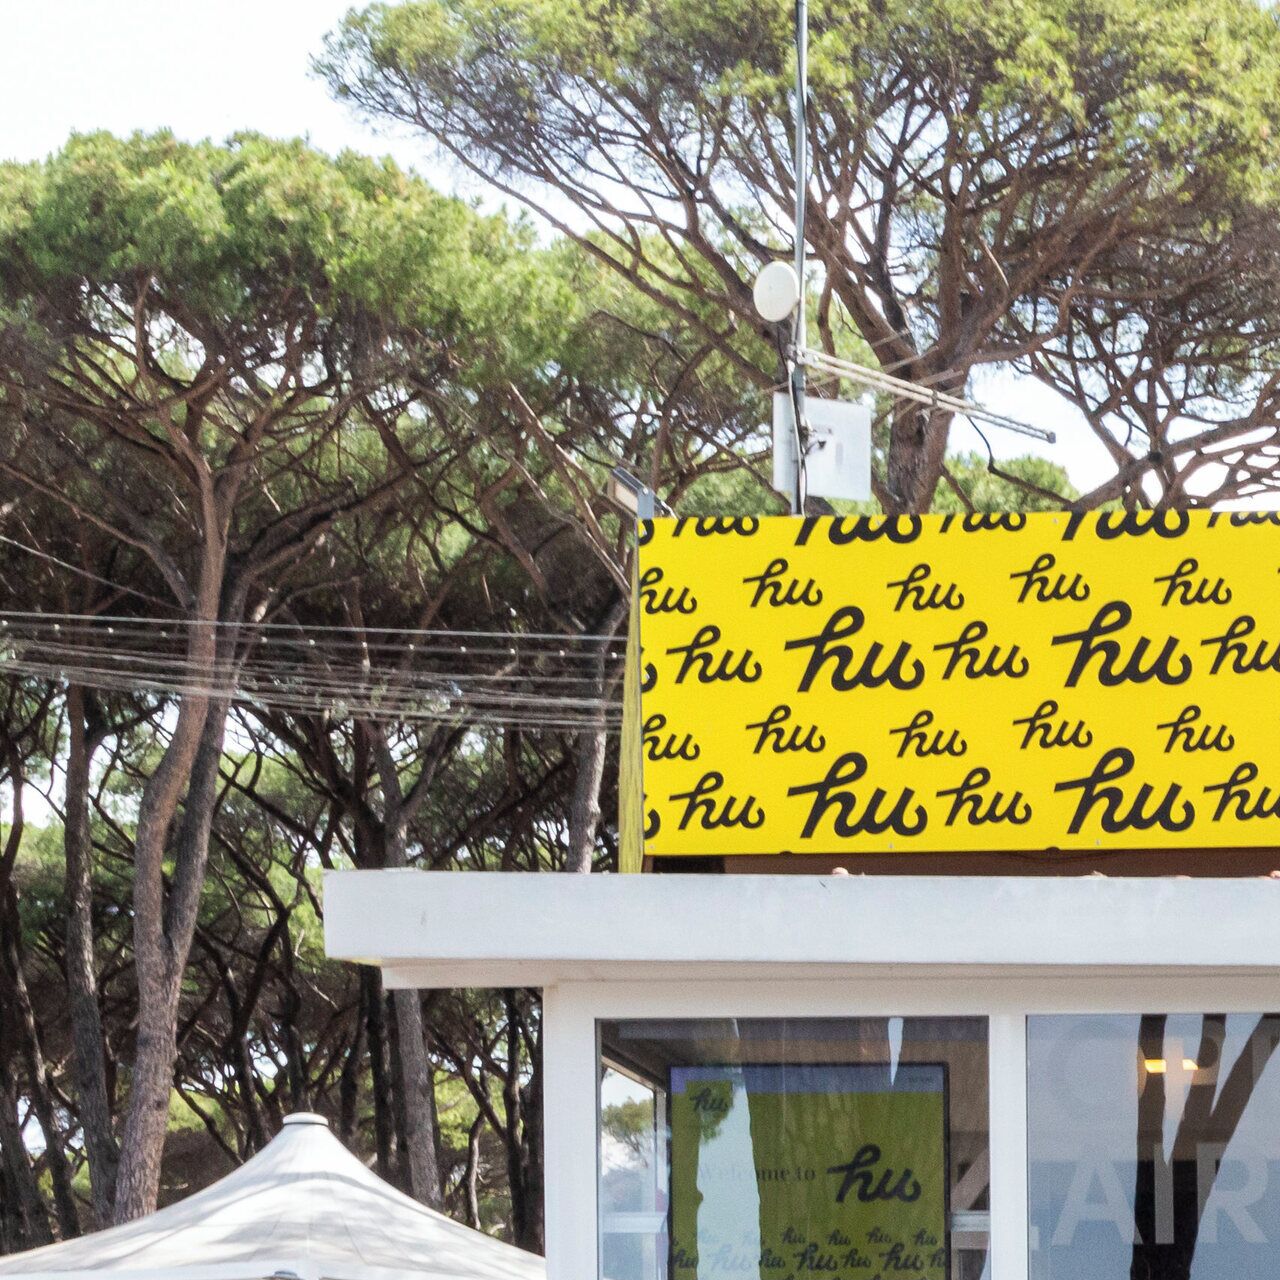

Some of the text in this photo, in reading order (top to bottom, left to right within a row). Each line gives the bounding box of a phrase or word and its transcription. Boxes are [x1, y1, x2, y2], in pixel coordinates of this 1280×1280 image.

[743, 559, 822, 607] hu
[887, 564, 964, 611] hu
[1011, 554, 1089, 602] hu
[1155, 559, 1231, 605] hu
[667, 626, 761, 683] hu
[785, 606, 924, 692] hu
[934, 621, 1028, 679] hu
[1052, 601, 1192, 687] hu
[746, 705, 825, 753] hu
[890, 711, 966, 757] hu
[1014, 701, 1092, 748] hu
[1158, 706, 1234, 752] hu
[669, 772, 764, 829] hu
[788, 753, 927, 838] hu
[937, 768, 1031, 825] hu
[1055, 748, 1195, 833] hu
[796, 1168, 816, 1182] to
[827, 1143, 922, 1203] hu
